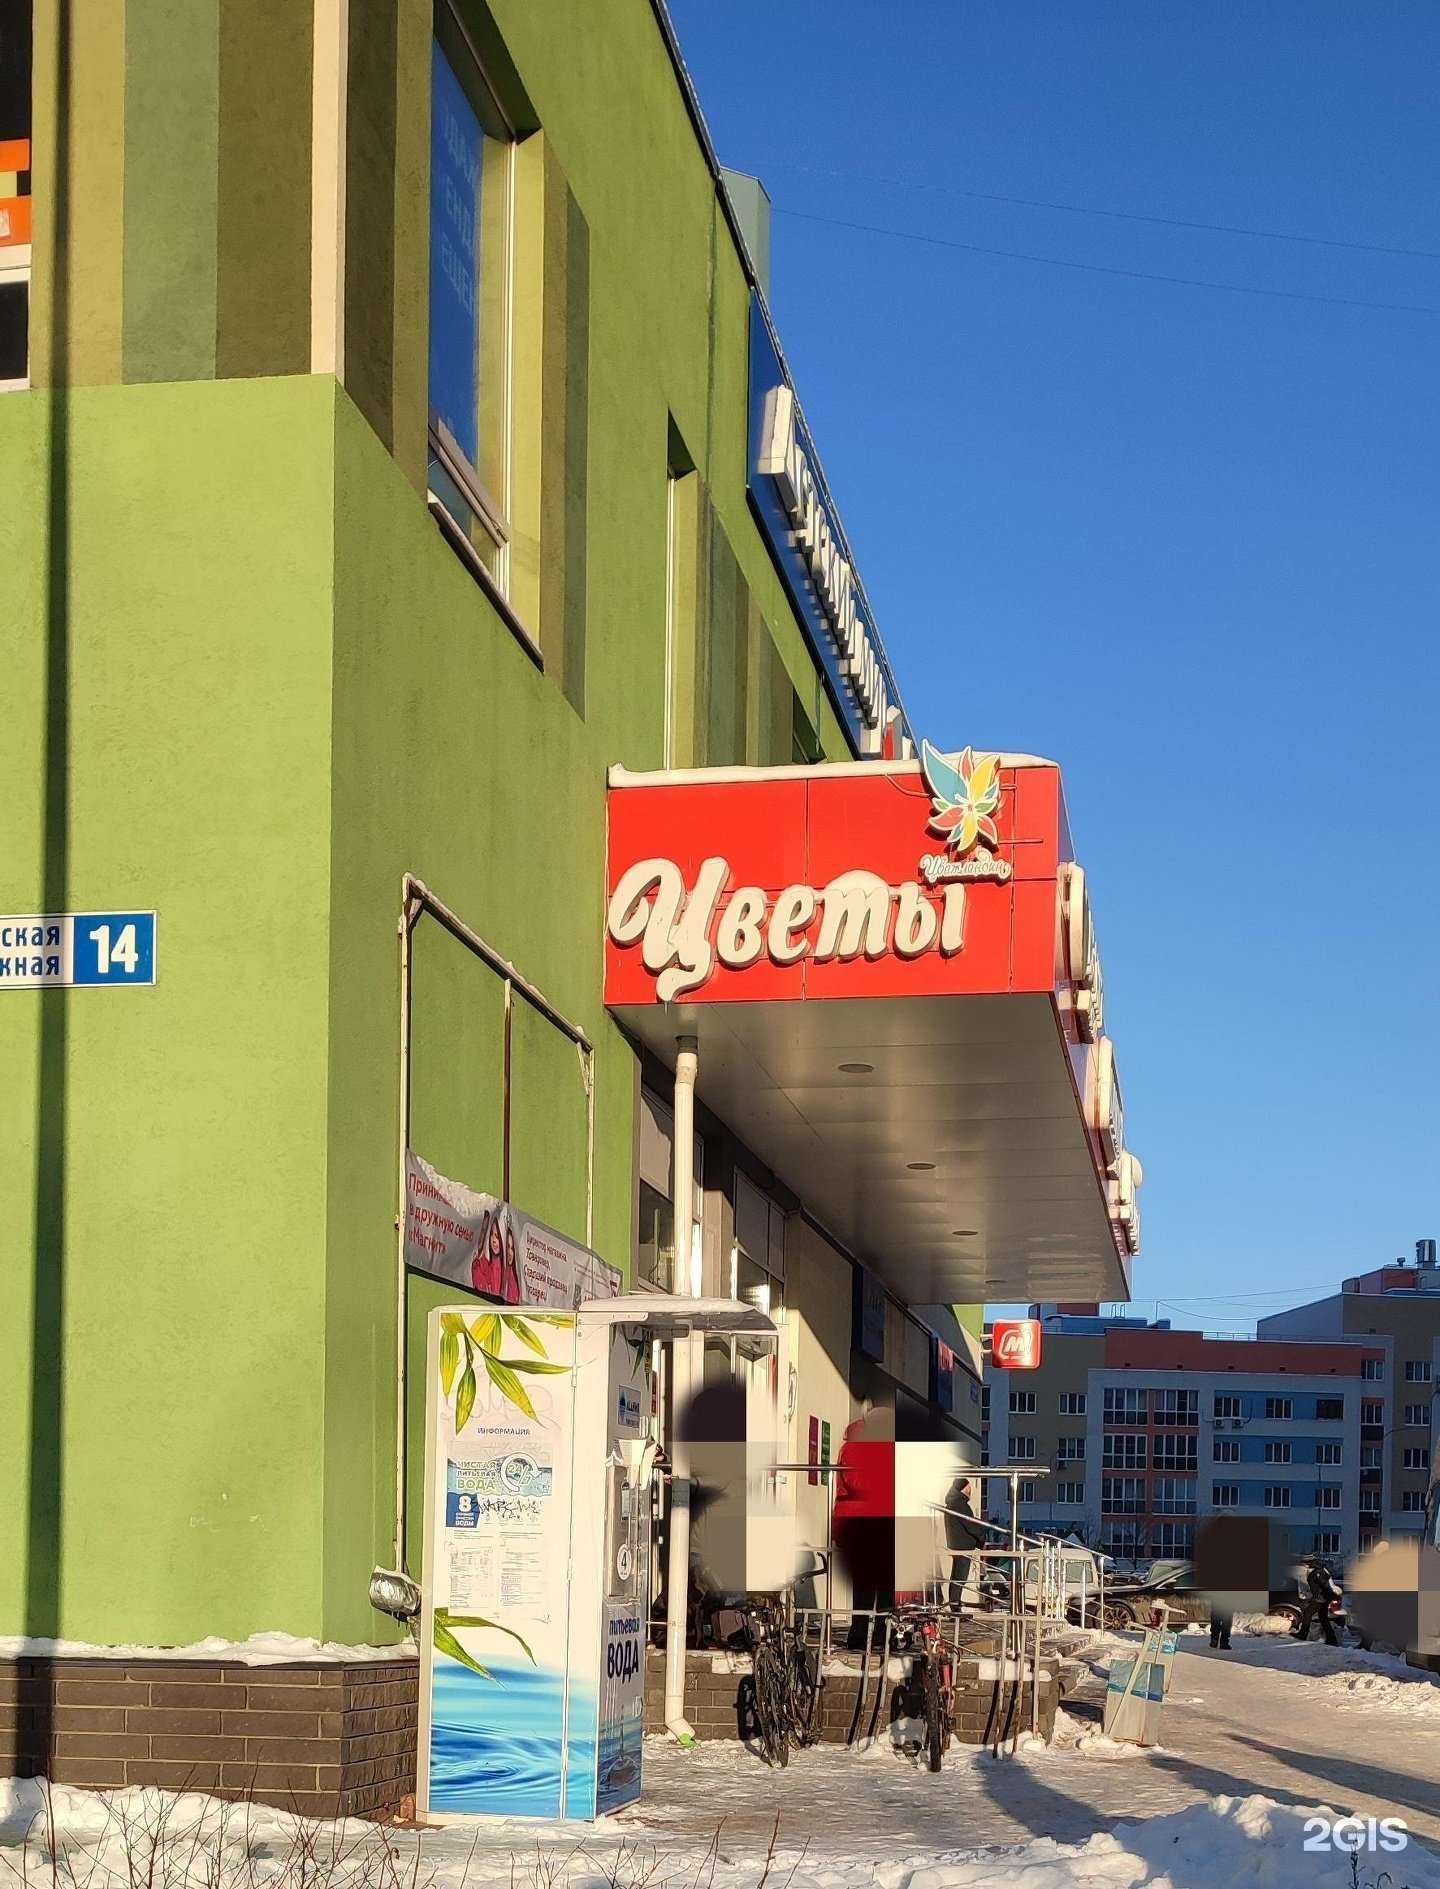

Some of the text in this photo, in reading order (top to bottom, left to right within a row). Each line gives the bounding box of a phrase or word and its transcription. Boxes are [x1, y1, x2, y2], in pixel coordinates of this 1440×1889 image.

[1, 926, 60, 947] ская
[608, 857, 968, 1001] Цветы
[89, 924, 139, 974] 14
[408, 1173, 445, 1203] Прини
[477, 1427, 531, 1435] ИНФОРМАЦИЯ
[457, 1480, 496, 1490] ВОДА
[458, 1495, 472, 1512] 8
[607, 1637, 640, 1684] ВОДА
